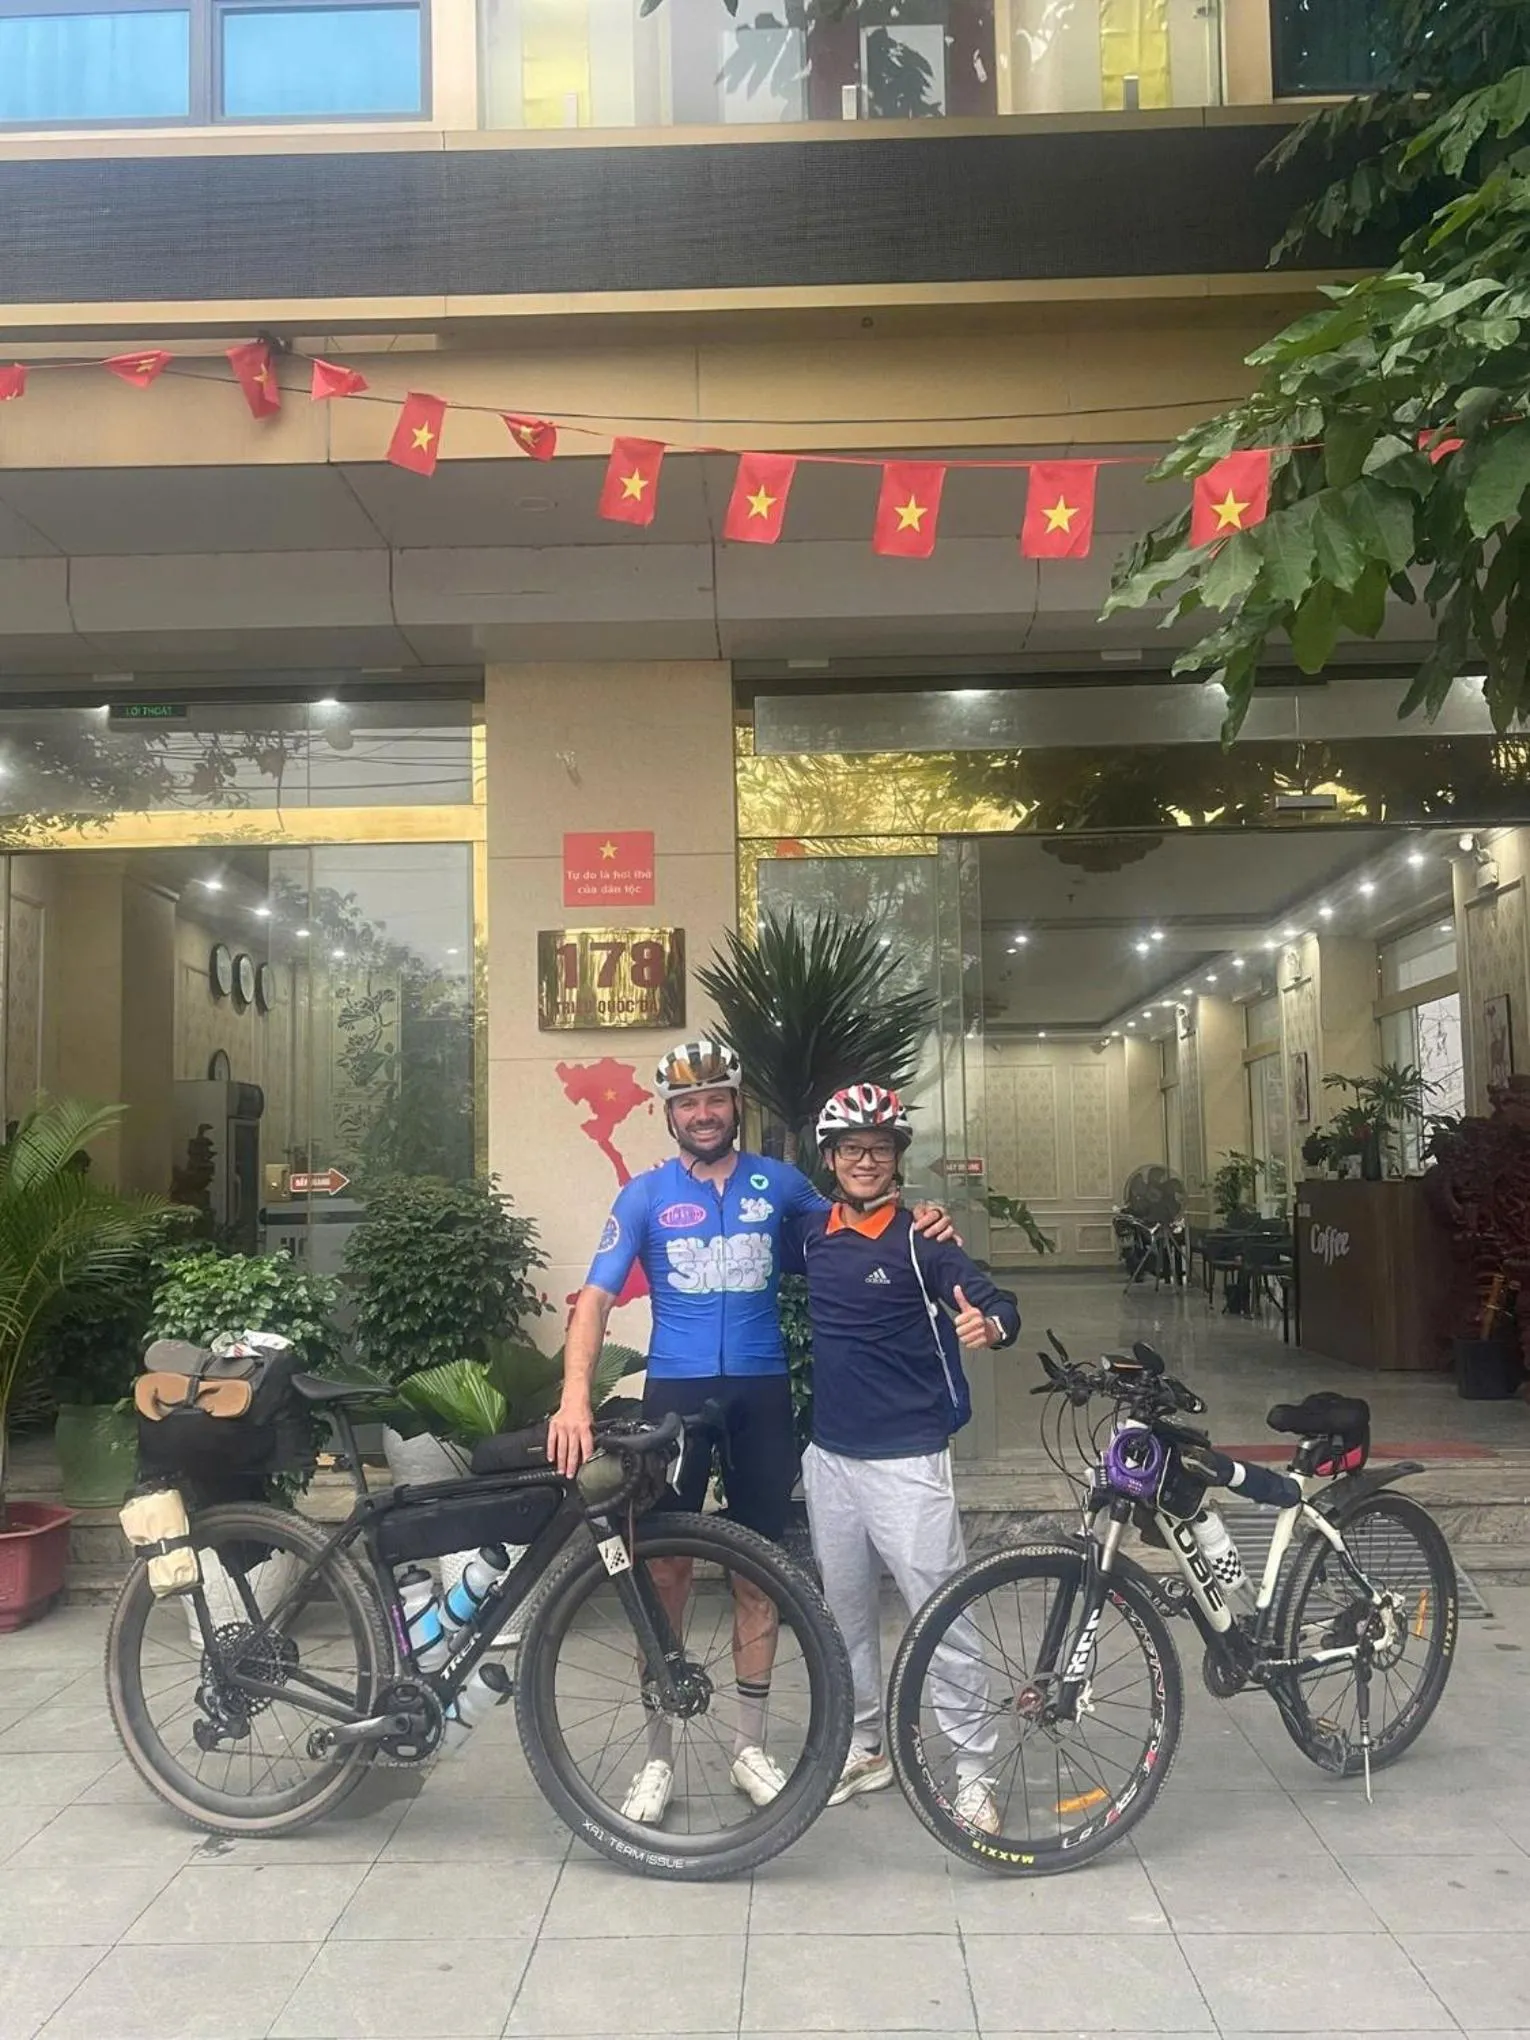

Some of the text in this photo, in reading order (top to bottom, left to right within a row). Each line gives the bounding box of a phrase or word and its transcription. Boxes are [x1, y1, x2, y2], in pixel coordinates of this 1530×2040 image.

[583, 869, 597, 880] do
[556, 940, 665, 989] 178
[1310, 1223, 1350, 1265] Coffee
[608, 1837, 645, 1861] TEAM
[645, 1853, 685, 1869] ISSUE
[972, 1840, 1034, 1864] MAXXIS
